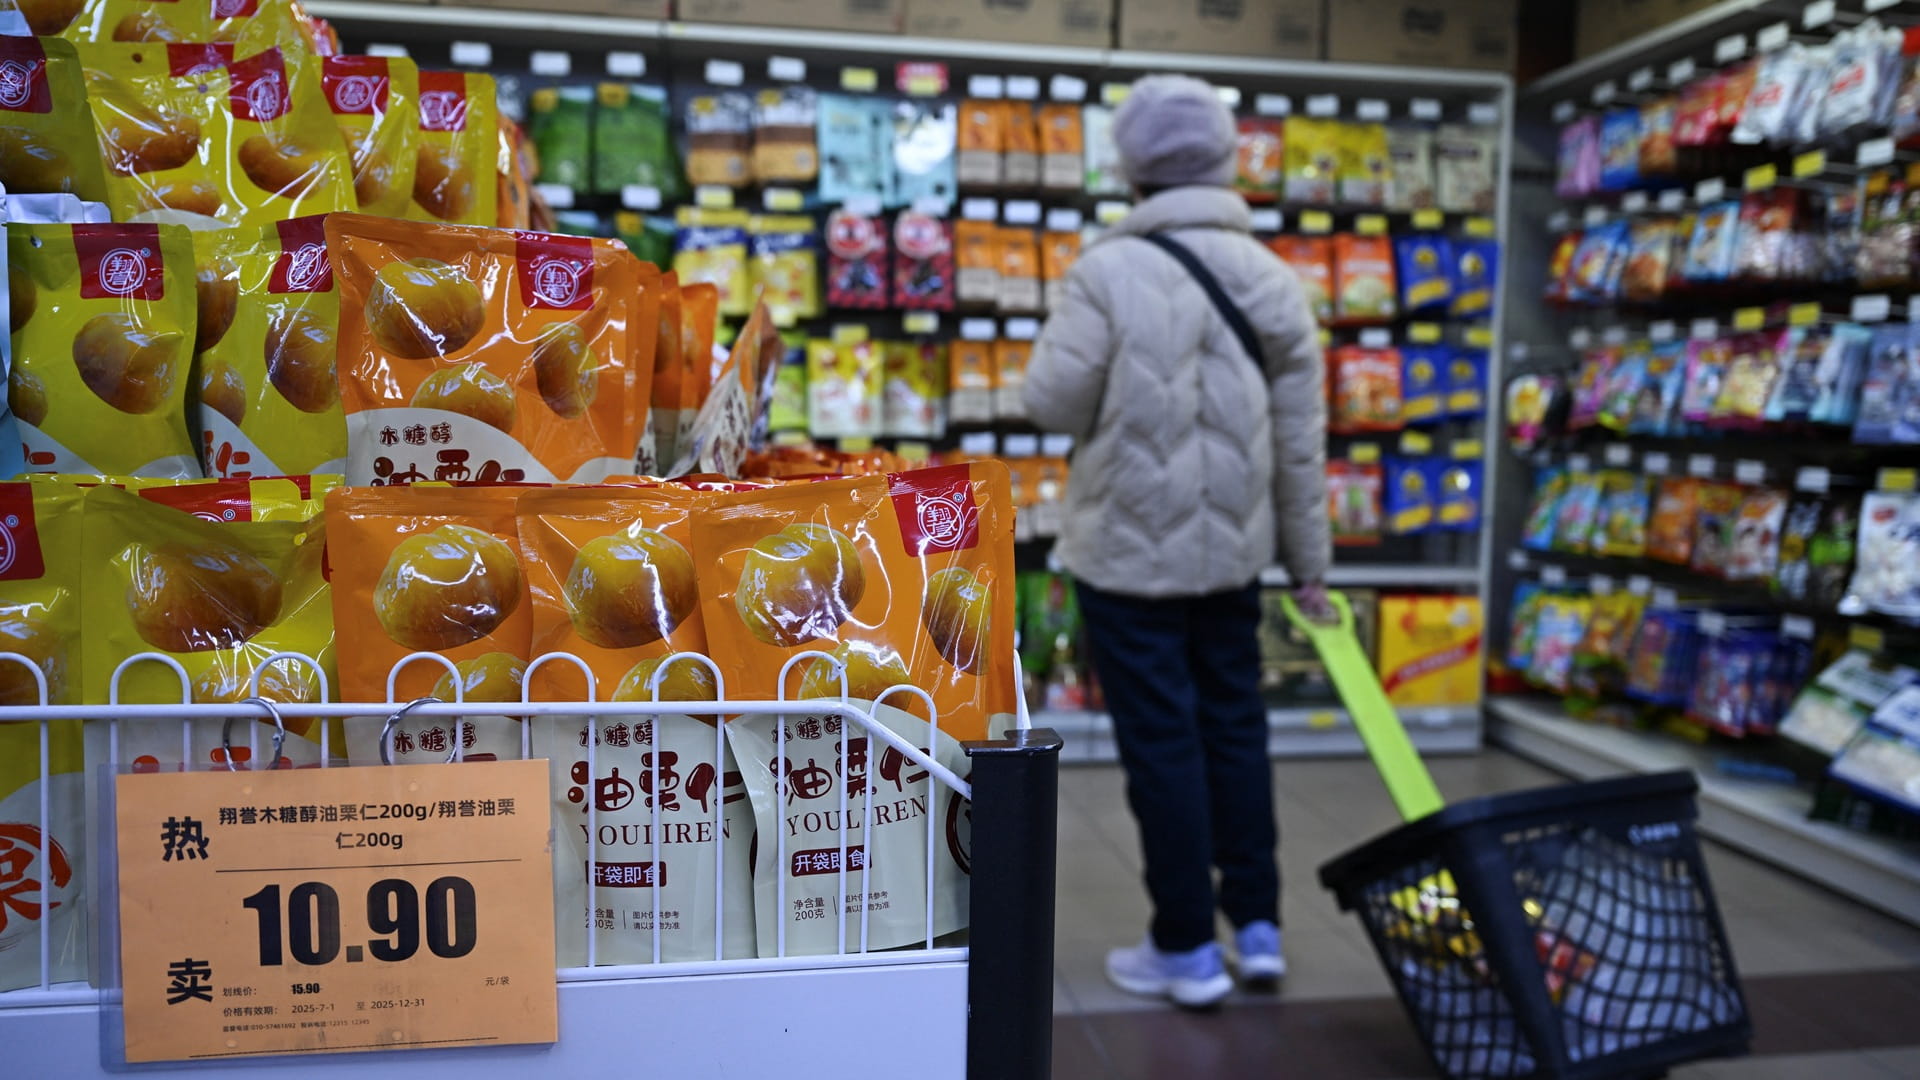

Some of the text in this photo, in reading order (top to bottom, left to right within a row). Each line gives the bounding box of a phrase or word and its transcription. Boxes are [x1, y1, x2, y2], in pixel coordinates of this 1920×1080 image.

[380, 421, 453, 447] 木糖醇
[219, 798, 516, 825] 翔誉木糖醇油栗仁200g/翔誉油栗
[335, 832, 404, 850] 仁200g
[160, 816, 213, 1005] 热 卖
[793, 897, 825, 910] 净含量
[243, 876, 477, 967] 10.90
[795, 908, 825, 921] 200克
[291, 983, 321, 995] 15.90
[485, 976, 510, 986] 元/袋
[291, 1003, 335, 1014] 2025-7-1
[371, 999, 426, 1009] 2025-12-31
